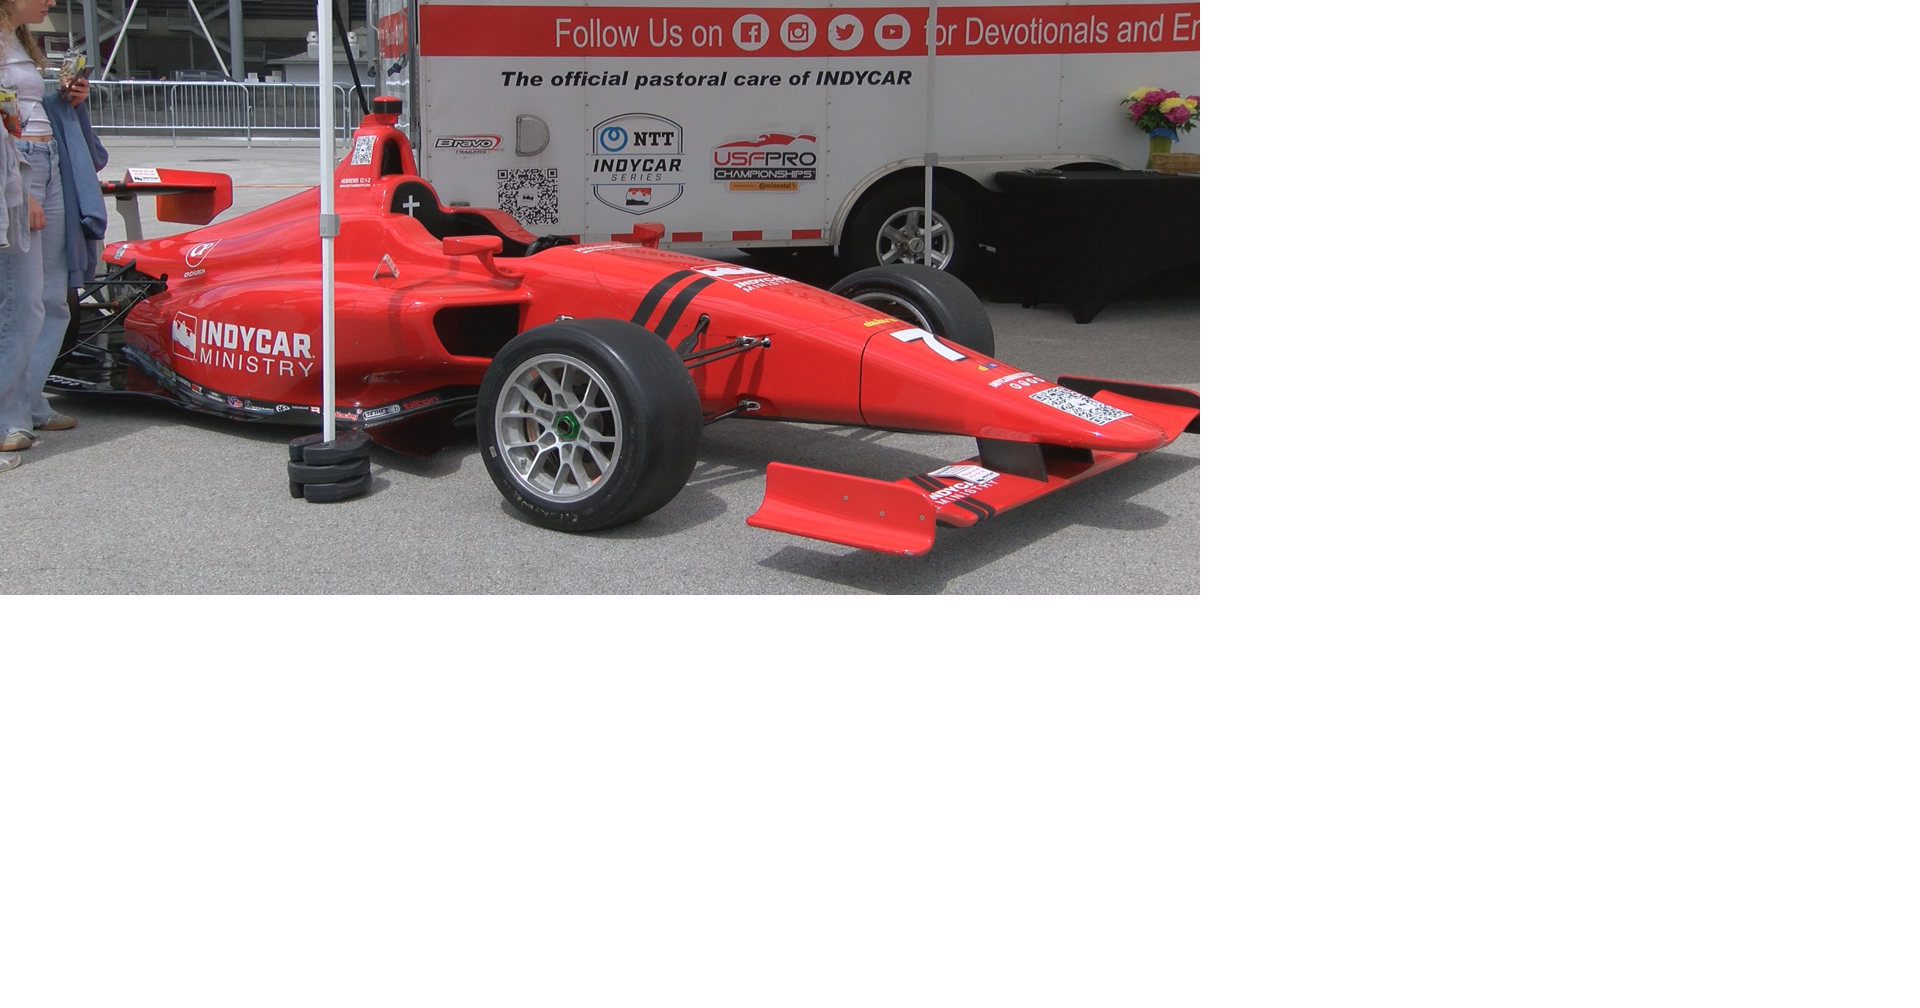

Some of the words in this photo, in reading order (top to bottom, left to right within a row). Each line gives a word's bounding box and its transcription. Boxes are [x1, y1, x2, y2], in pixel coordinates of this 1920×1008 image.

[555, 18, 640, 48] Follow
[649, 17, 683, 47] Us
[691, 24, 723, 47] on
[965, 14, 1108, 46] Devotionals
[1116, 13, 1164, 43] and
[501, 71, 543, 87] The
[551, 71, 629, 87] official
[634, 71, 728, 90] pastoral
[733, 74, 782, 87] care
[788, 71, 811, 87] of
[815, 70, 912, 86] INDYCAR
[434, 138, 493, 148] Bravo
[633, 131, 674, 146] NTT
[593, 158, 682, 172] INDYCAR
[611, 173, 662, 181] SERIES
[715, 169, 813, 179] CHAMPIONSHIPS
[200, 319, 313, 359] INDYCAR
[889, 327, 969, 362] 7
[200, 347, 314, 378] MINISTRY
